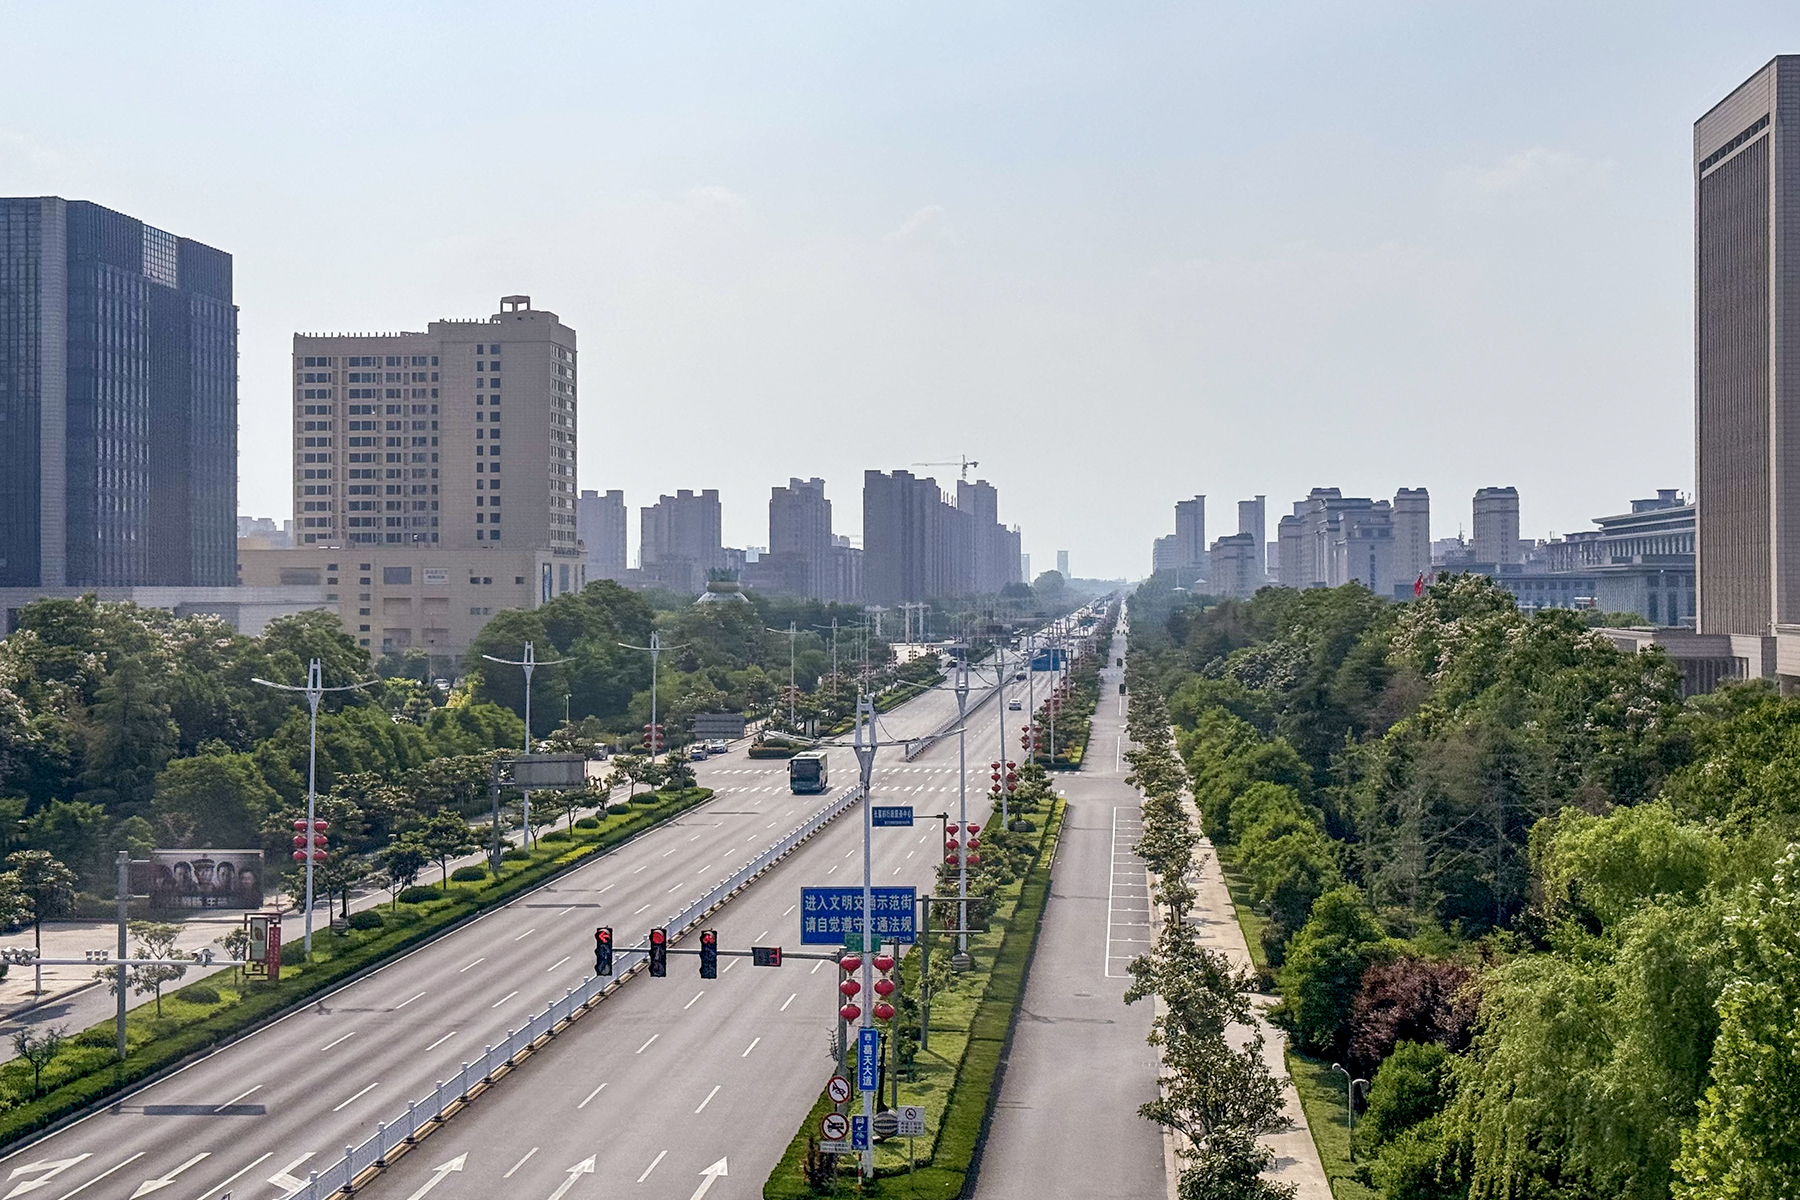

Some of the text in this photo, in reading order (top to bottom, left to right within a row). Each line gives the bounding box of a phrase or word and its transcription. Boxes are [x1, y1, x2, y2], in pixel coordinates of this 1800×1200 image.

[805, 894, 912, 910] 进入文明交通示范街
[805, 916, 912, 932] 请自觉遵守交通法规
